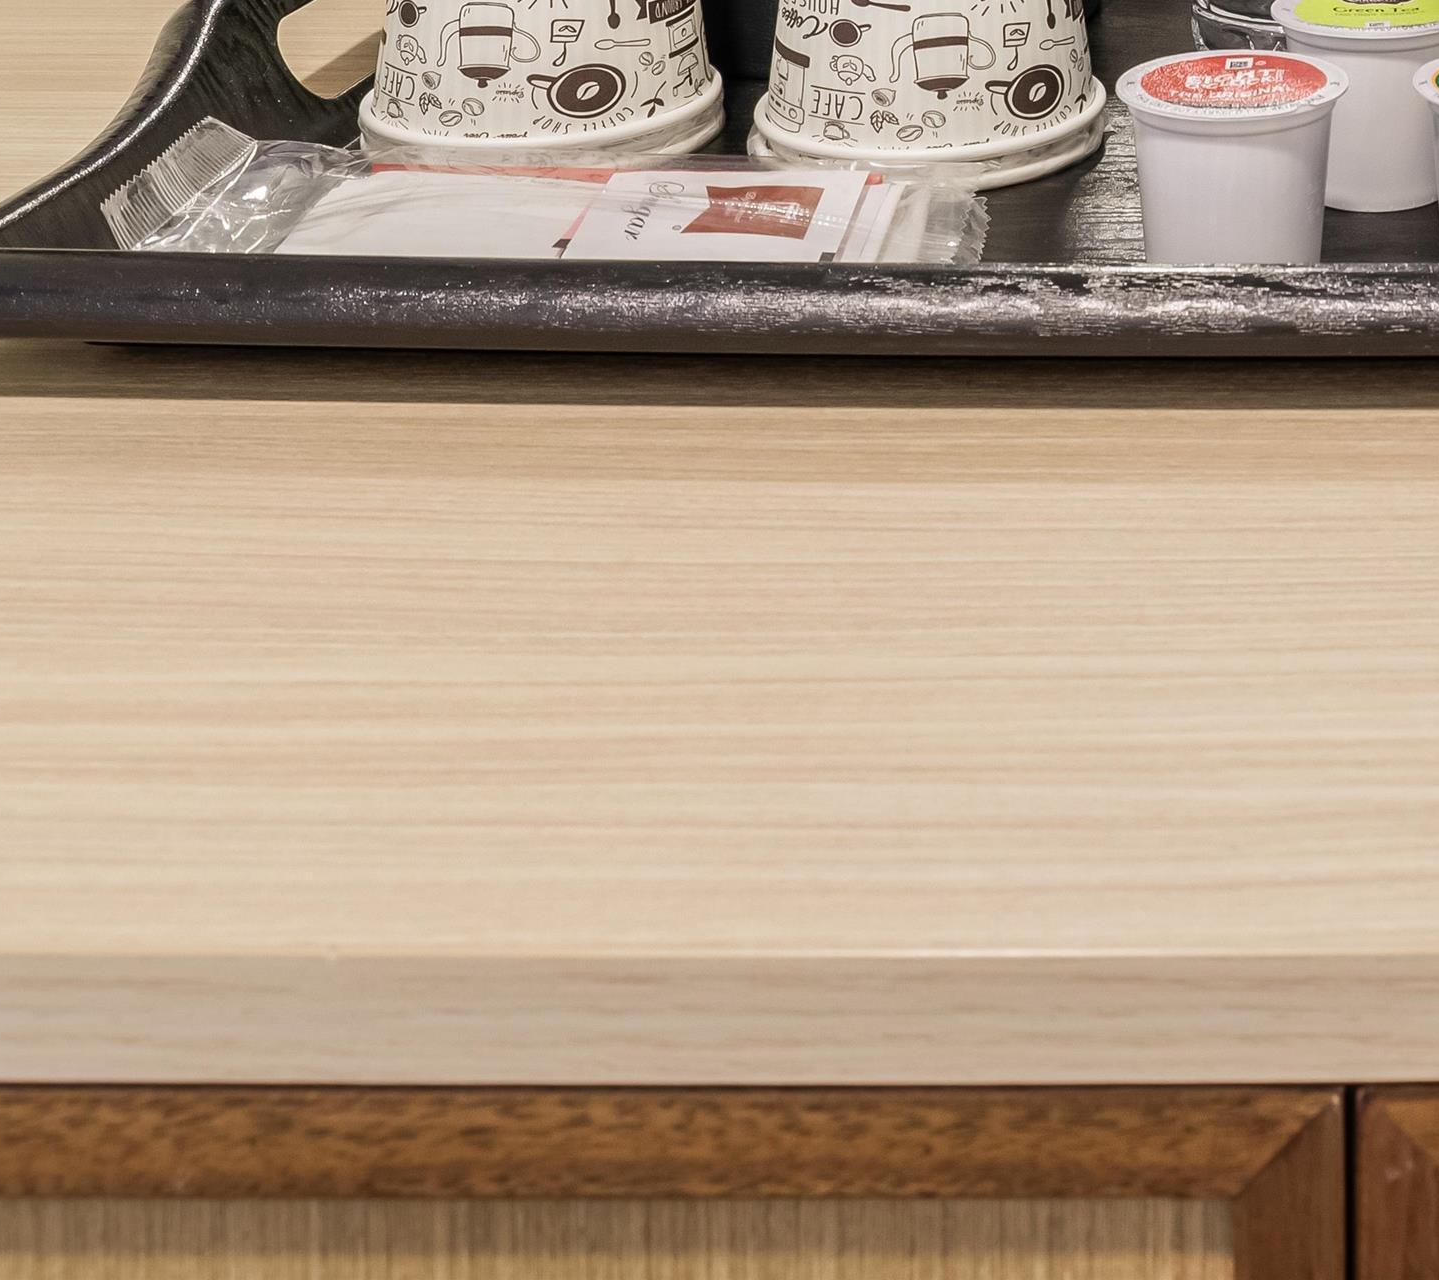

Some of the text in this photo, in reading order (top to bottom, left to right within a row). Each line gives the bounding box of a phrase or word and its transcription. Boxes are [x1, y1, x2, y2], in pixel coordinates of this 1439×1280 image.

[781, 7, 829, 40] Coffee
[384, 66, 415, 100] CAFE
[530, 106, 634, 135] COFFEE SHOP
[810, 89, 862, 121] CAFE
[992, 105, 1072, 136] COFFEE SHOP
